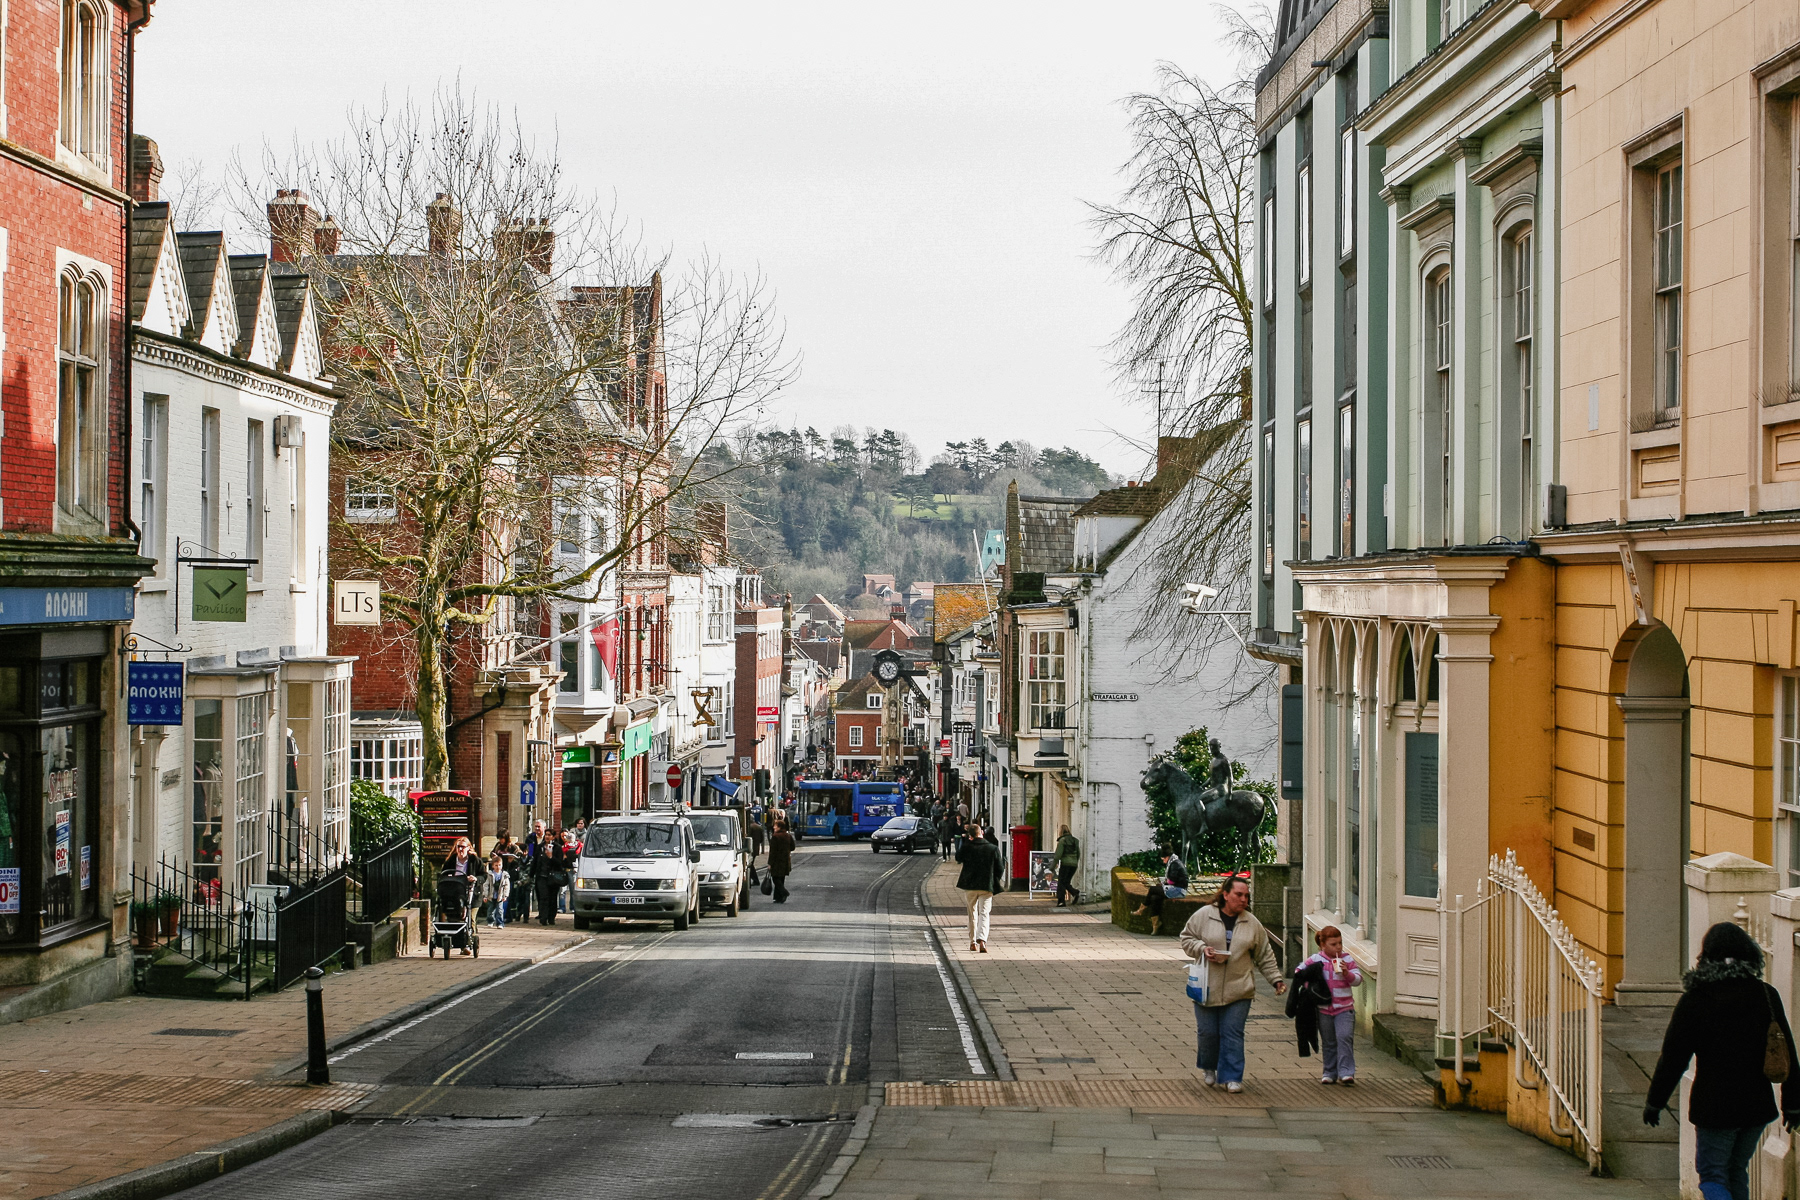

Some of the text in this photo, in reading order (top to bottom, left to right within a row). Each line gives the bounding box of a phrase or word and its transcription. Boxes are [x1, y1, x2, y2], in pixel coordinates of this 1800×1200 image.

[45, 592, 88, 617] ANOKHI
[195, 603, 245, 615] Pavilion
[341, 591, 373, 613] LTS
[129, 686, 181, 699] ANOKHI
[48, 768, 78, 804] SALE
[57, 860, 67, 868] OFF
